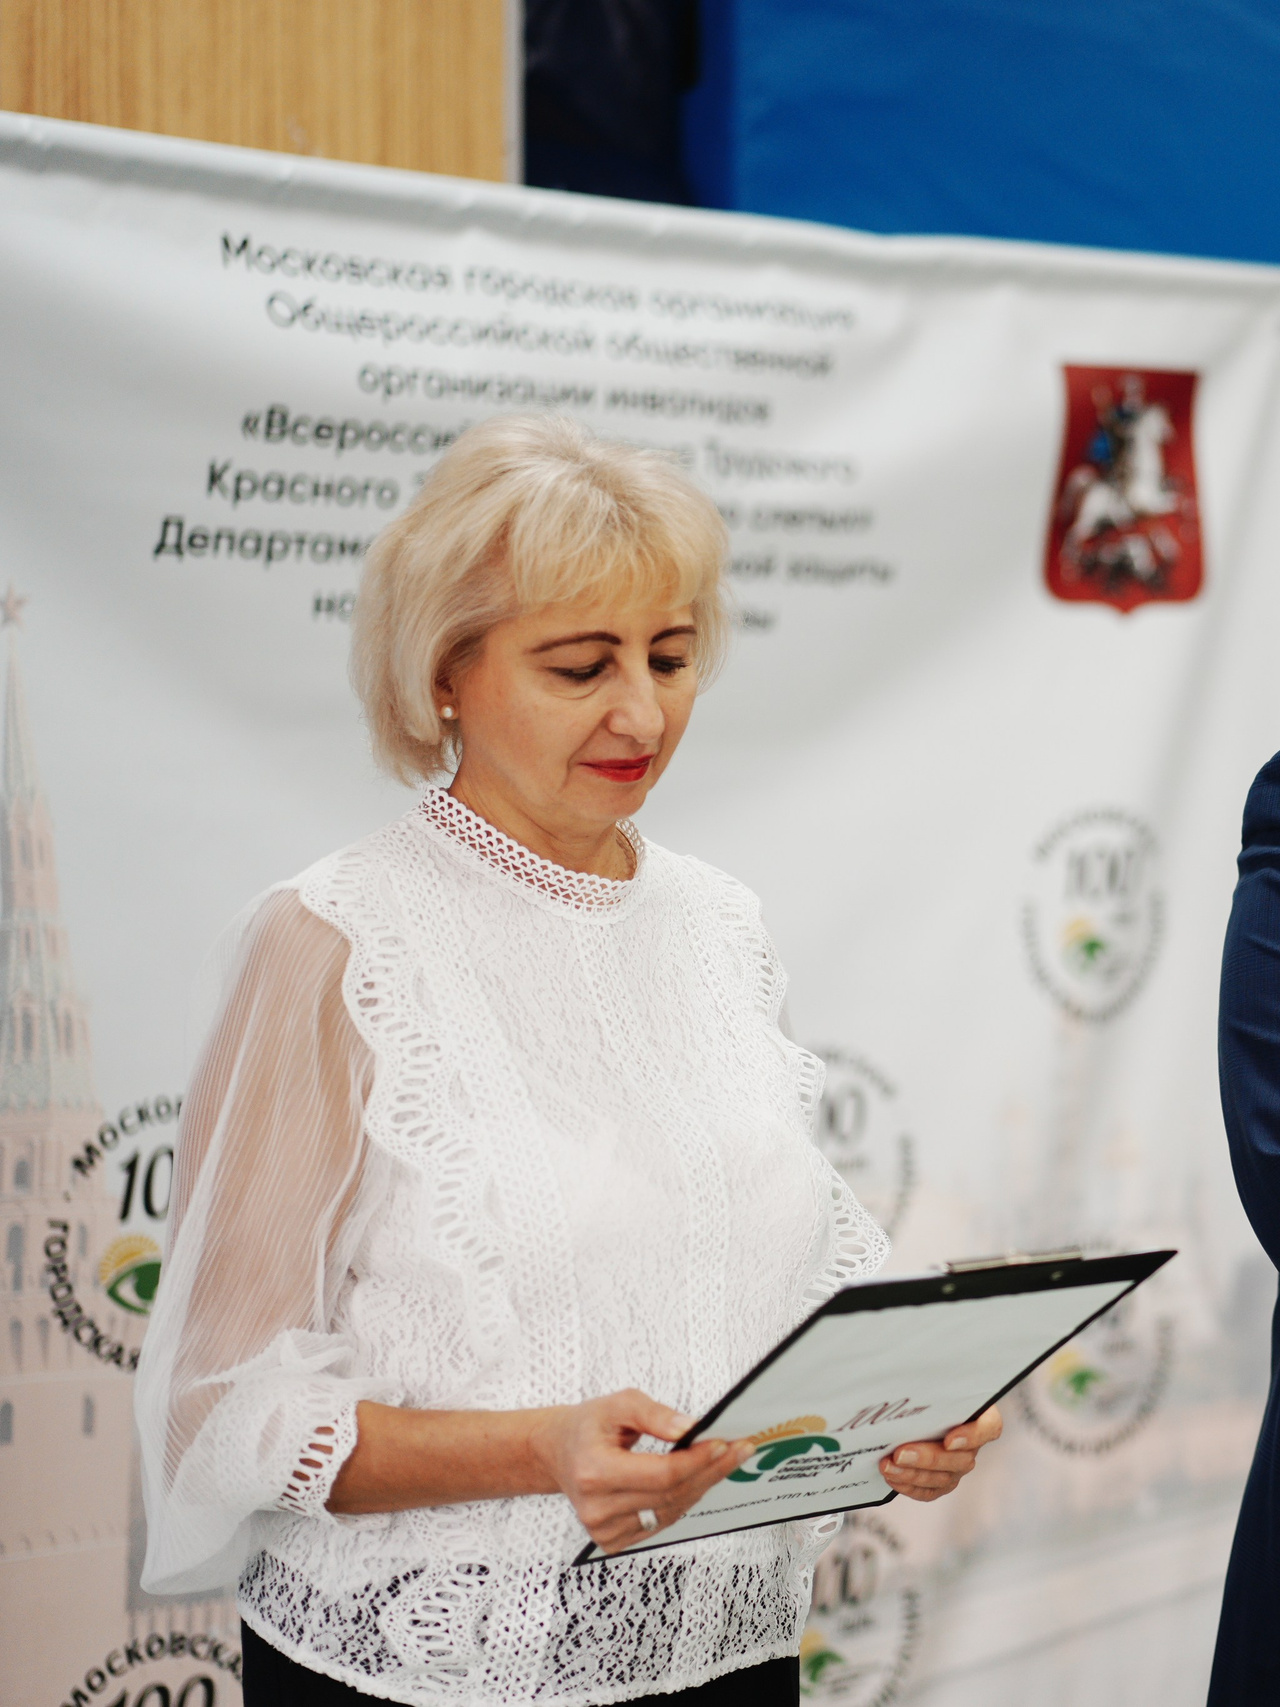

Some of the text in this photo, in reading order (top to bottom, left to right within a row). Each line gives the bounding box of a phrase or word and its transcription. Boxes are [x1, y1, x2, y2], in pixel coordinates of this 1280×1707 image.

[220, 231, 452, 291] Московская
[265, 289, 597, 358] Общероссийской
[240, 403, 466, 457] «Всеросси
[206, 457, 399, 512] Красного
[151, 514, 370, 570] Департам
[71, 1094, 184, 1178] МОСКО
[119, 1145, 174, 1223] 10
[767, 1471, 820, 1483] СЛЕПЫХ
